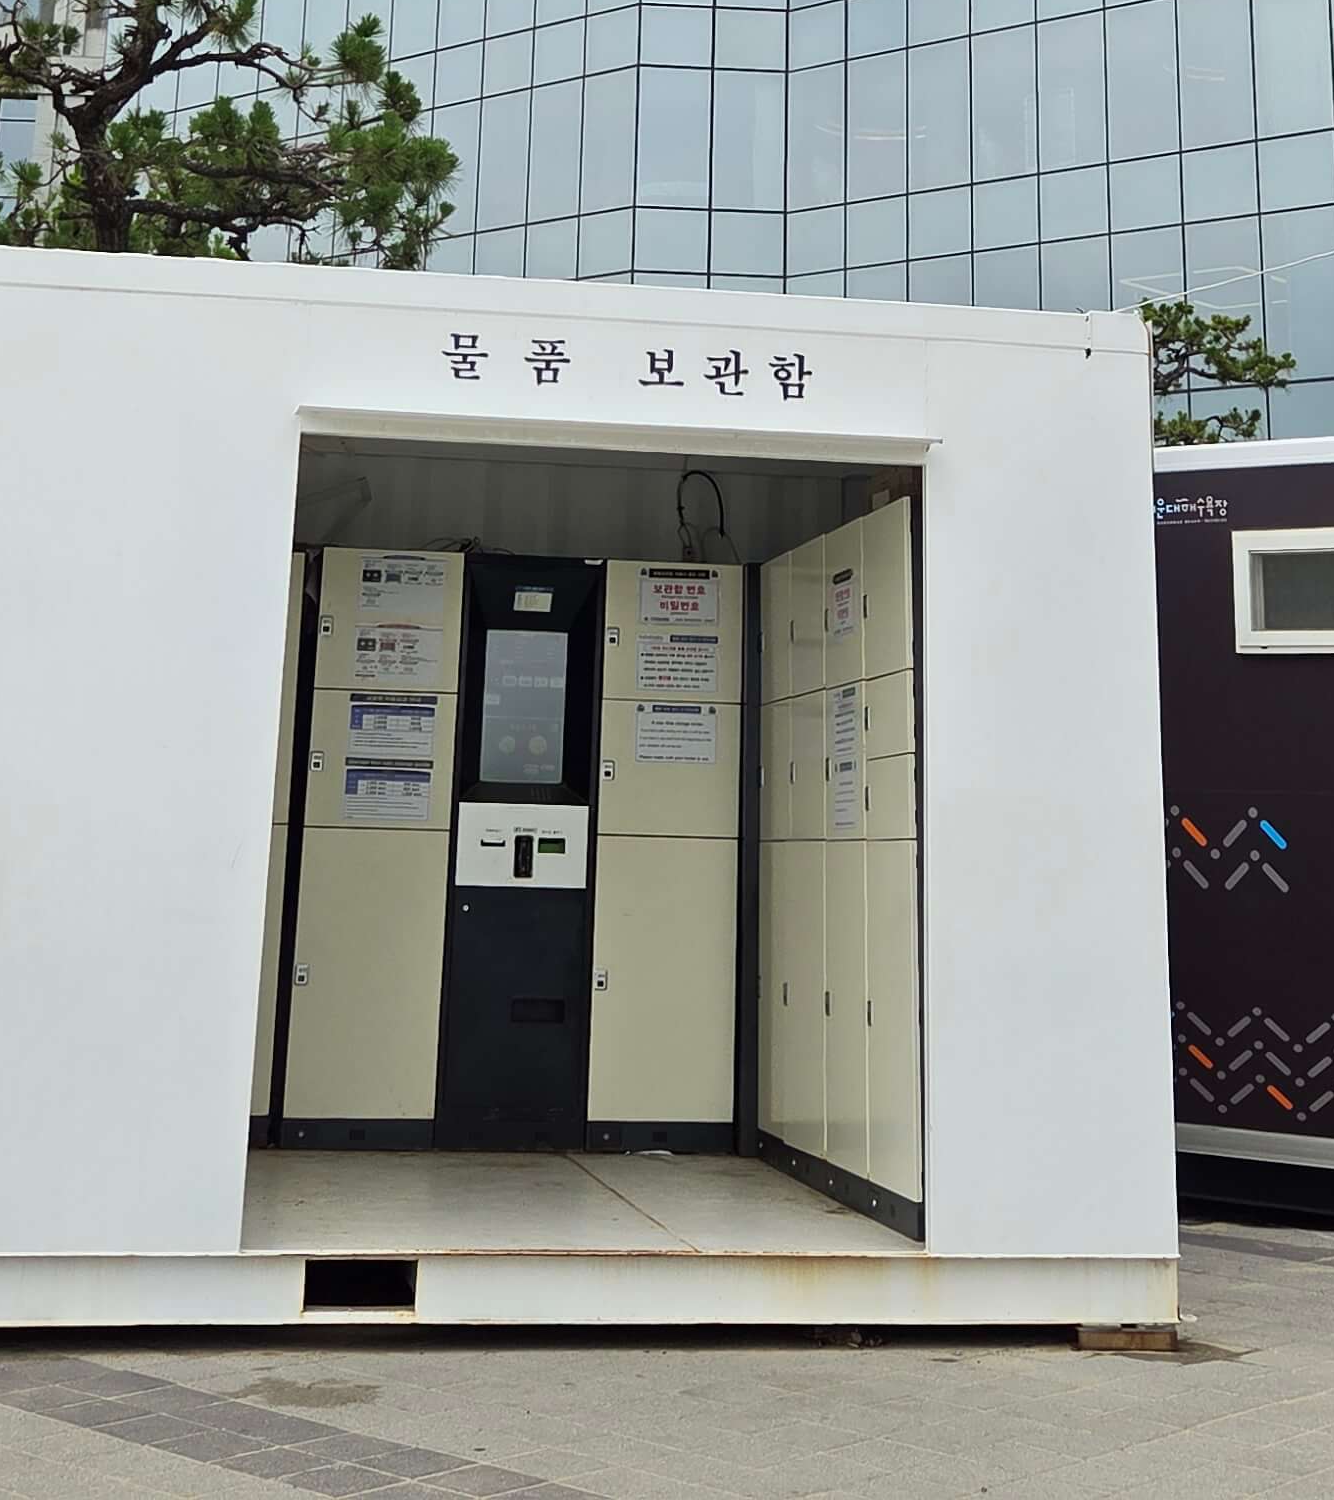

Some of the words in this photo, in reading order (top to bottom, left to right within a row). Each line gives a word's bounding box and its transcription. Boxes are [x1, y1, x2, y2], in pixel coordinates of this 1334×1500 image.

[441, 332, 572, 385] 물품
[638, 348, 814, 401] 보관함
[1155, 496, 1228, 519] 운대해수욕장
[653, 584, 683, 595] 보관함
[686, 585, 706, 595] 번호
[660, 601, 699, 611] 비밀번호
